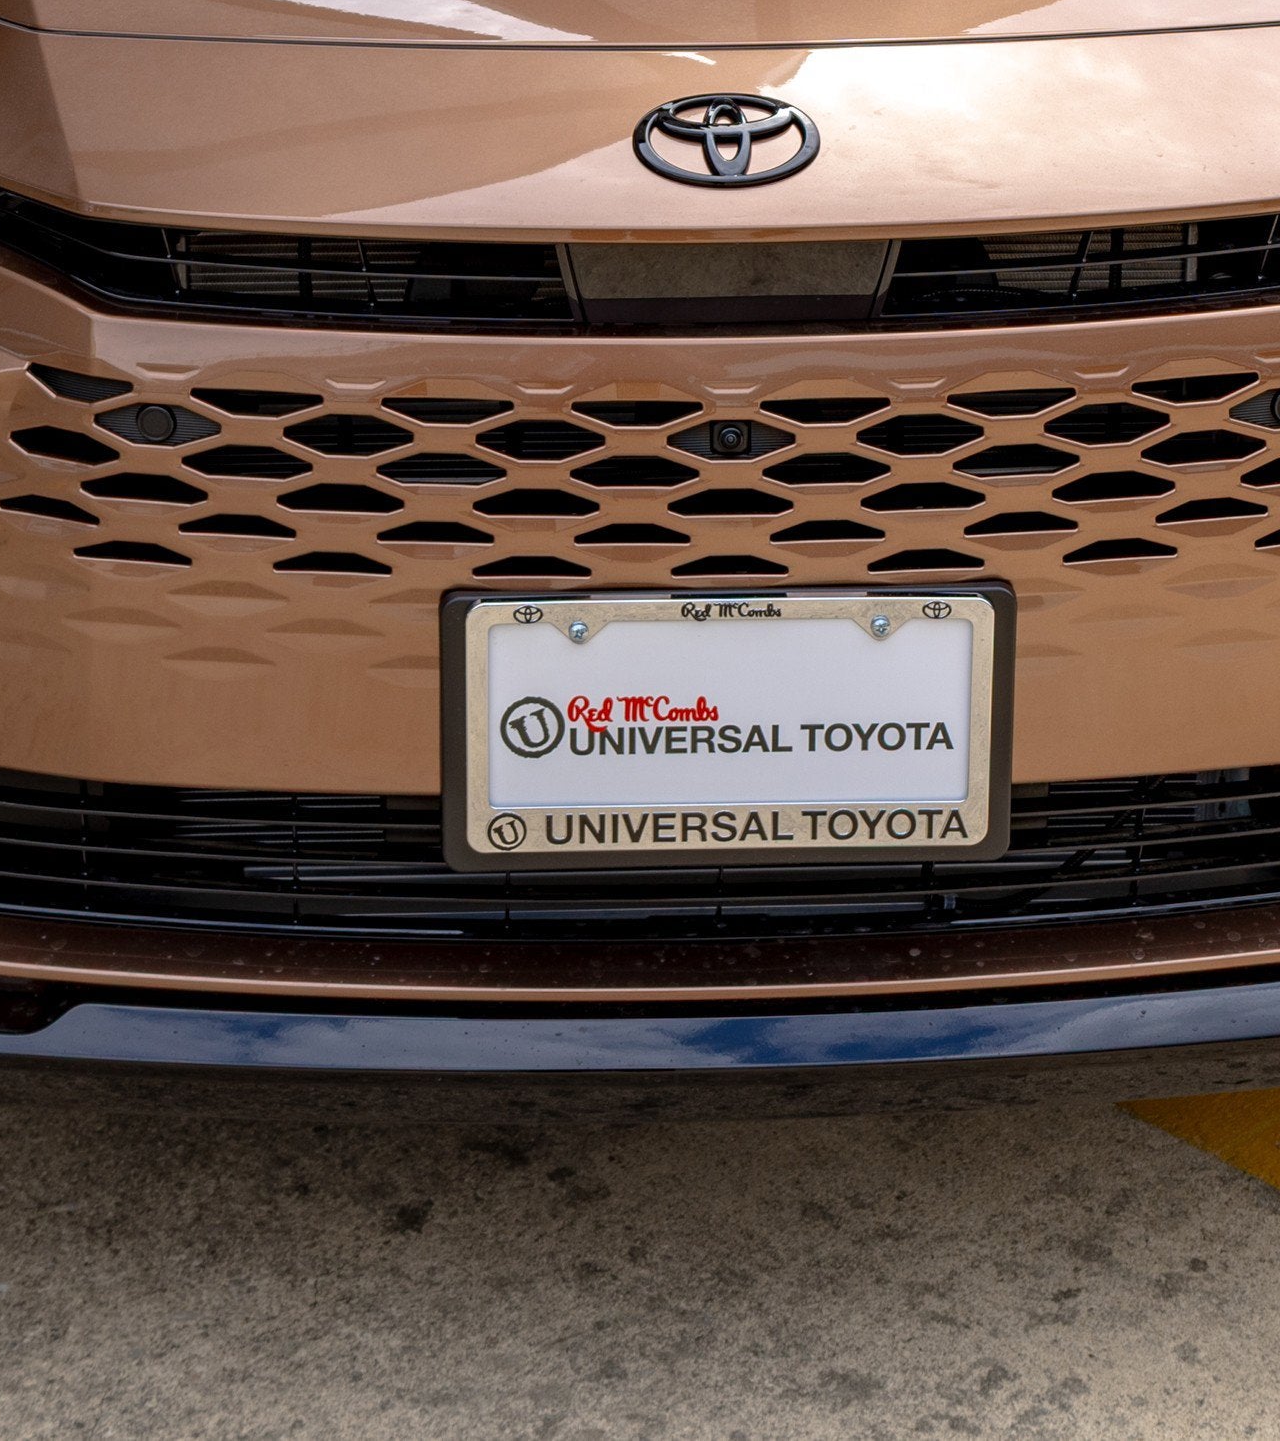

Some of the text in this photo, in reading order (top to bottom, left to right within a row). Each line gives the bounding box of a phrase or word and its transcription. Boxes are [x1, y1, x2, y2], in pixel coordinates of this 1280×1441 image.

[680, 601, 782, 622] Red McCombs
[567, 695, 719, 733] Red McCombs
[568, 722, 954, 756] UNIVERSAL TOYOTA
[544, 811, 795, 846] UNIVERSAL
[801, 808, 969, 842] TOYOTA
